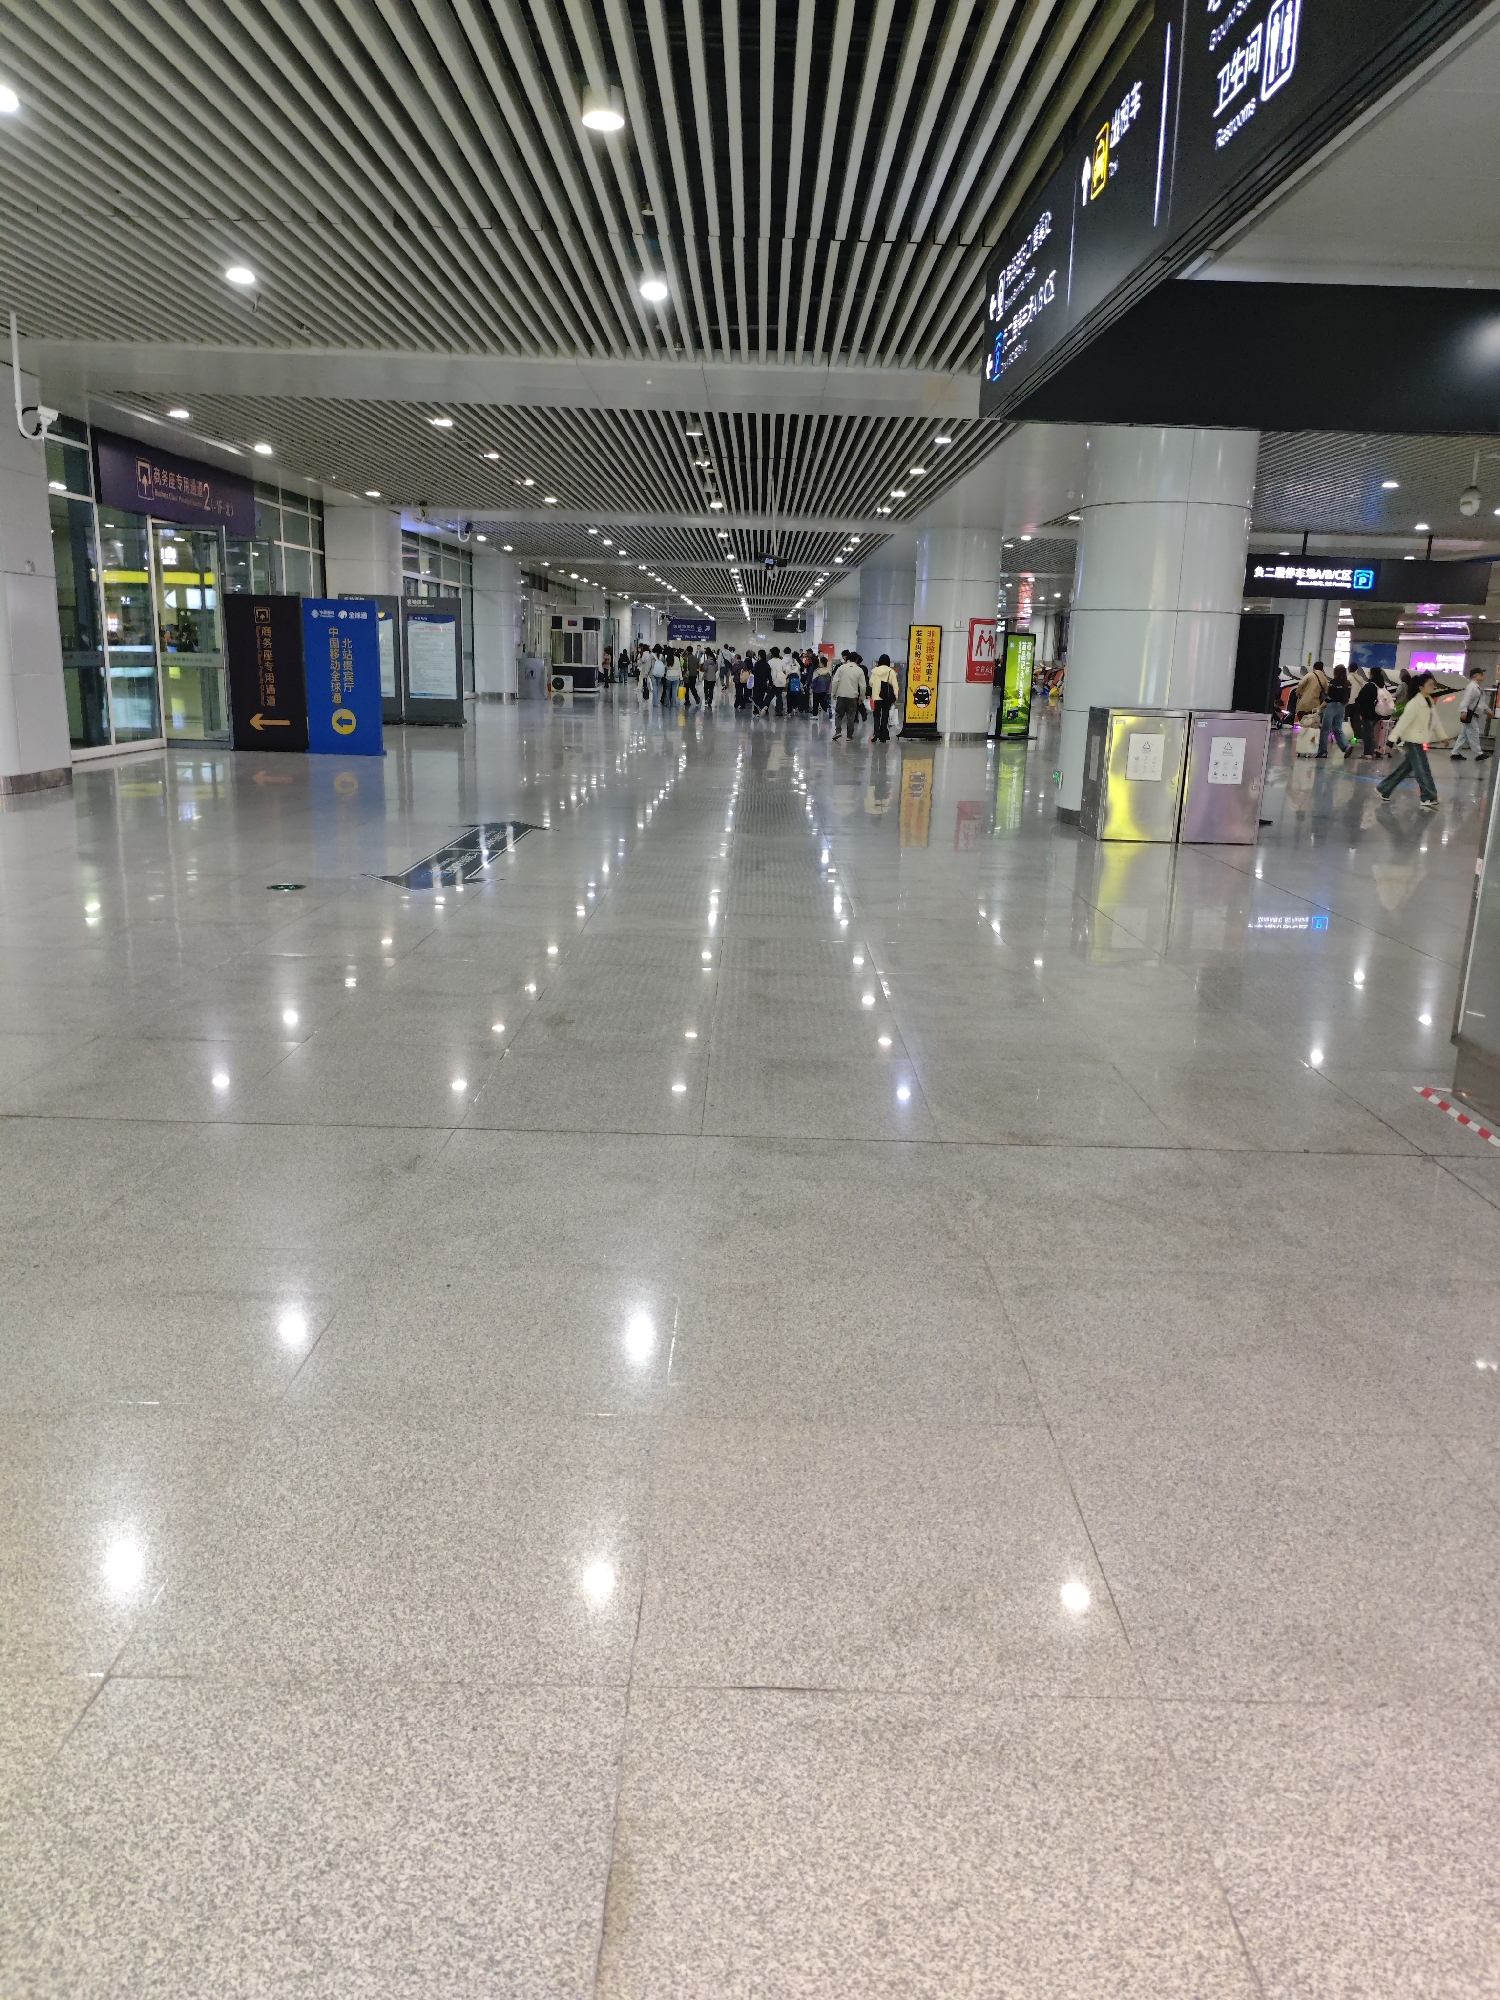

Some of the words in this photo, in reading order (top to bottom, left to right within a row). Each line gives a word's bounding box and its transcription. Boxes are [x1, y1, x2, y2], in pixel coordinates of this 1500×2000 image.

[1212, 22, 1262, 118] 卫生间
[1109, 81, 1142, 149] 出租车
[1215, 97, 1256, 149] Restrooms
[348, 611, 368, 620] 全球通
[261, 626, 276, 707] 商务座专用通道
[328, 626, 342, 704] 中国移动全球通
[341, 638, 355, 693] 北站贵宾厅
[912, 630, 923, 682] 发生纠纷没保障
[925, 630, 936, 682] 非法揽客不要上
